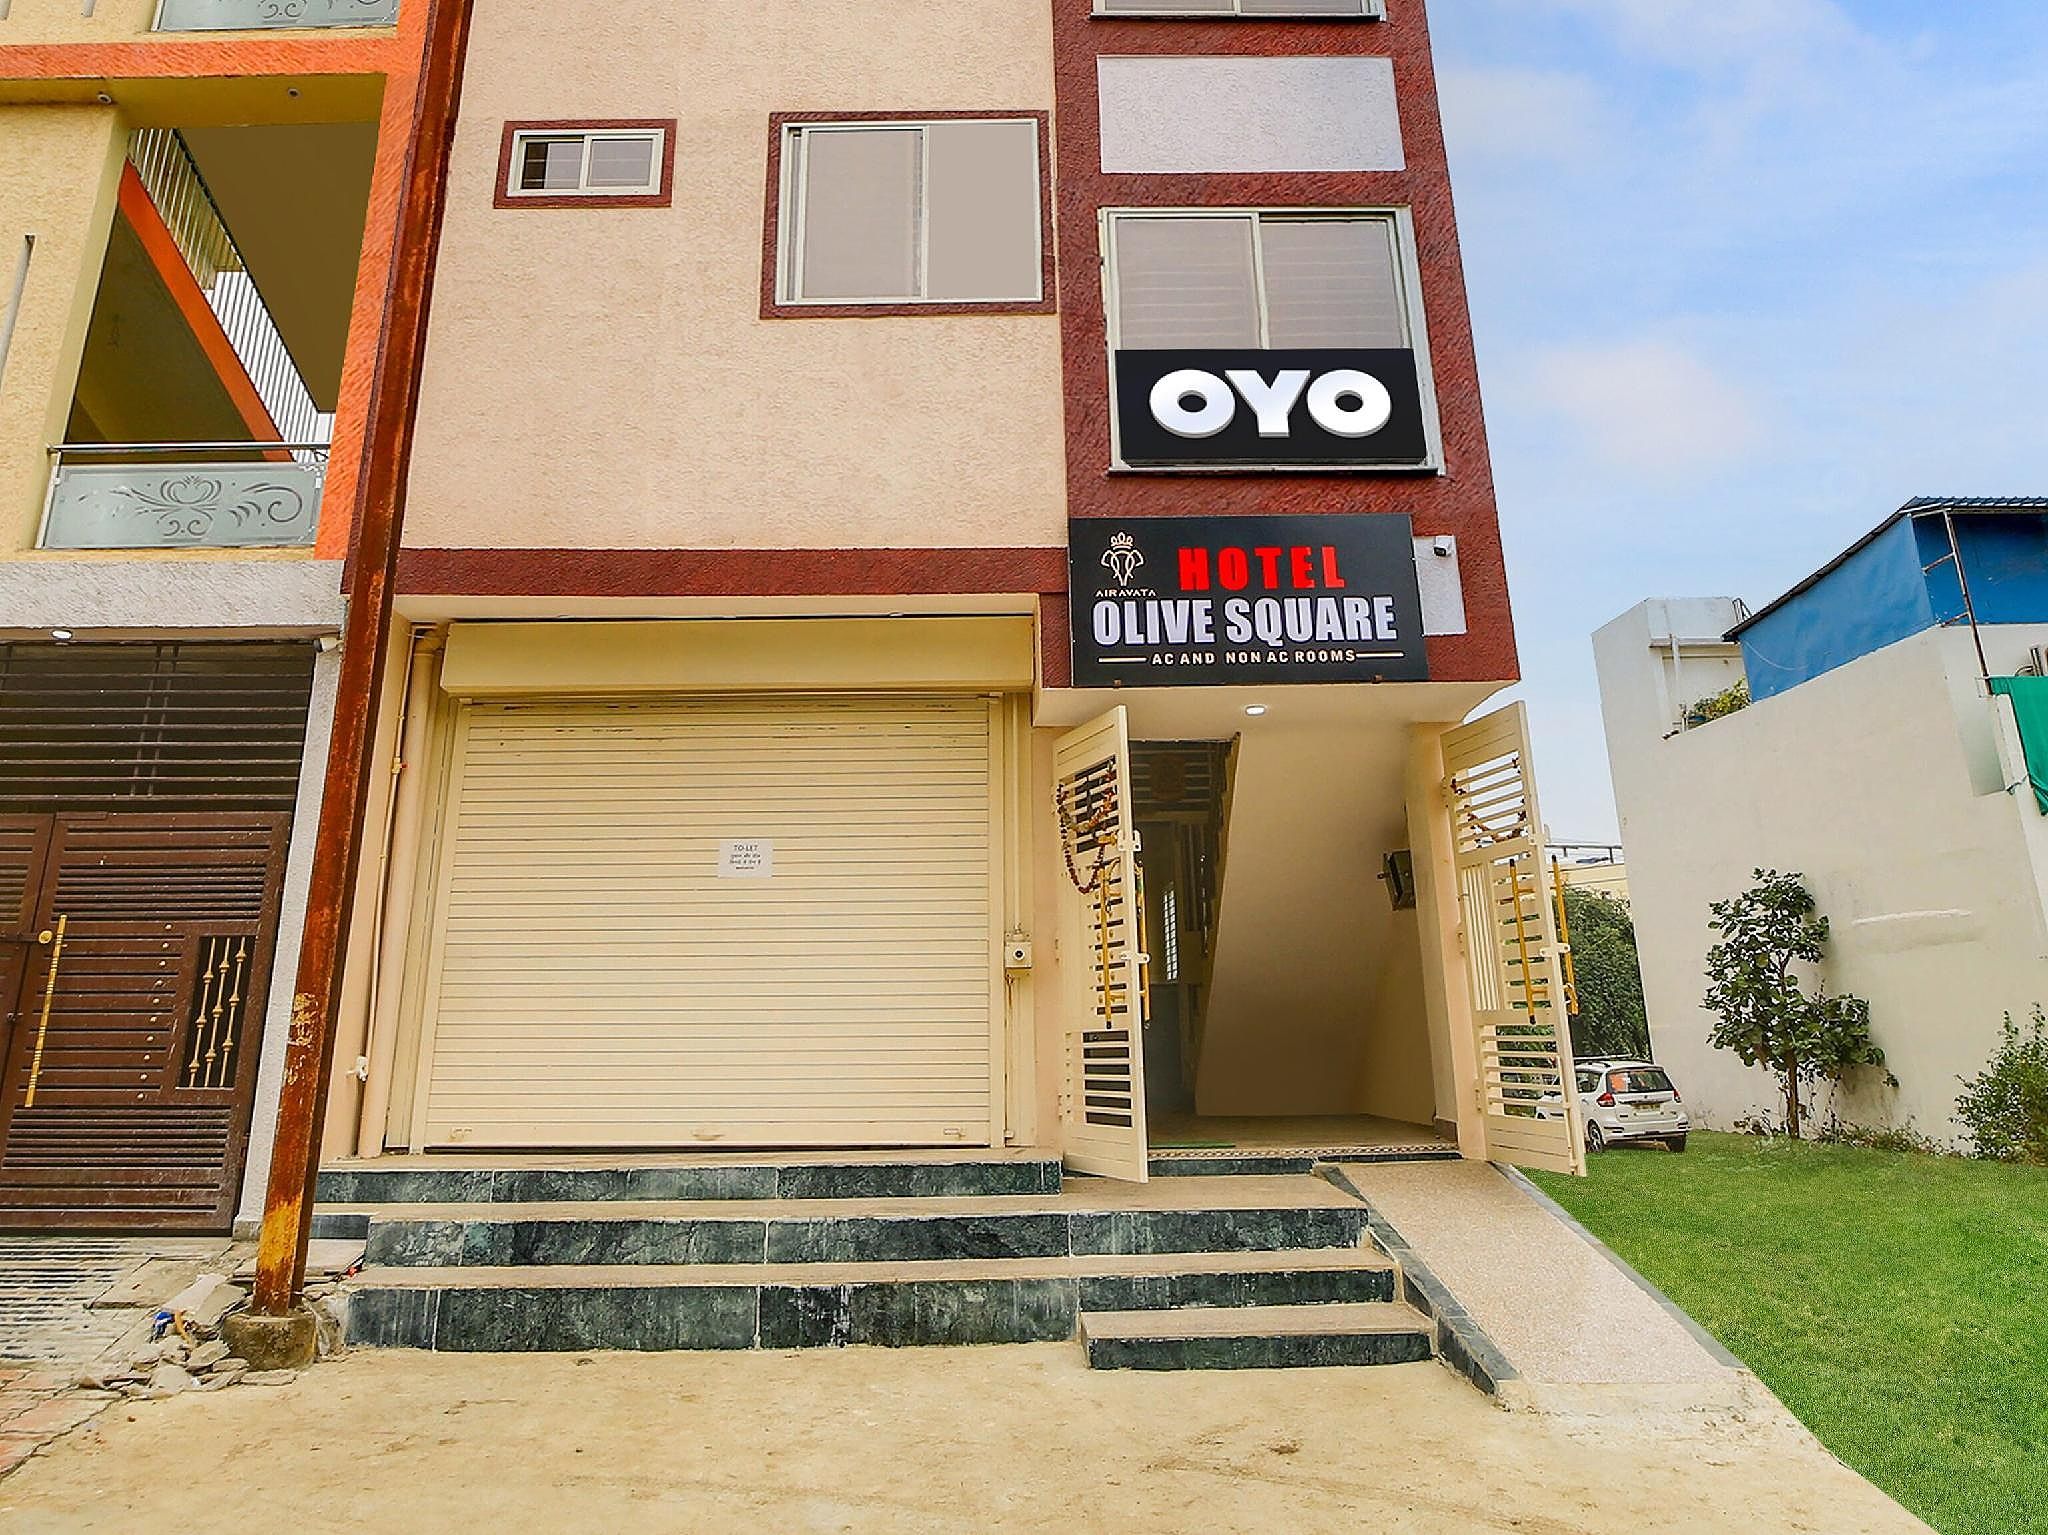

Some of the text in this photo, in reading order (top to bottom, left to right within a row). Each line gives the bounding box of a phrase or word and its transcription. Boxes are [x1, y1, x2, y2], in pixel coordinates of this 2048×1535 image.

[1149, 369, 1391, 438] OYO
[1177, 546, 1345, 591] HOTEL
[1095, 588, 1157, 598] AIRAVATA
[1093, 596, 1398, 647] OLIVE SQUARE
[1151, 650, 1356, 665] AC AND NON AC ROOMS
